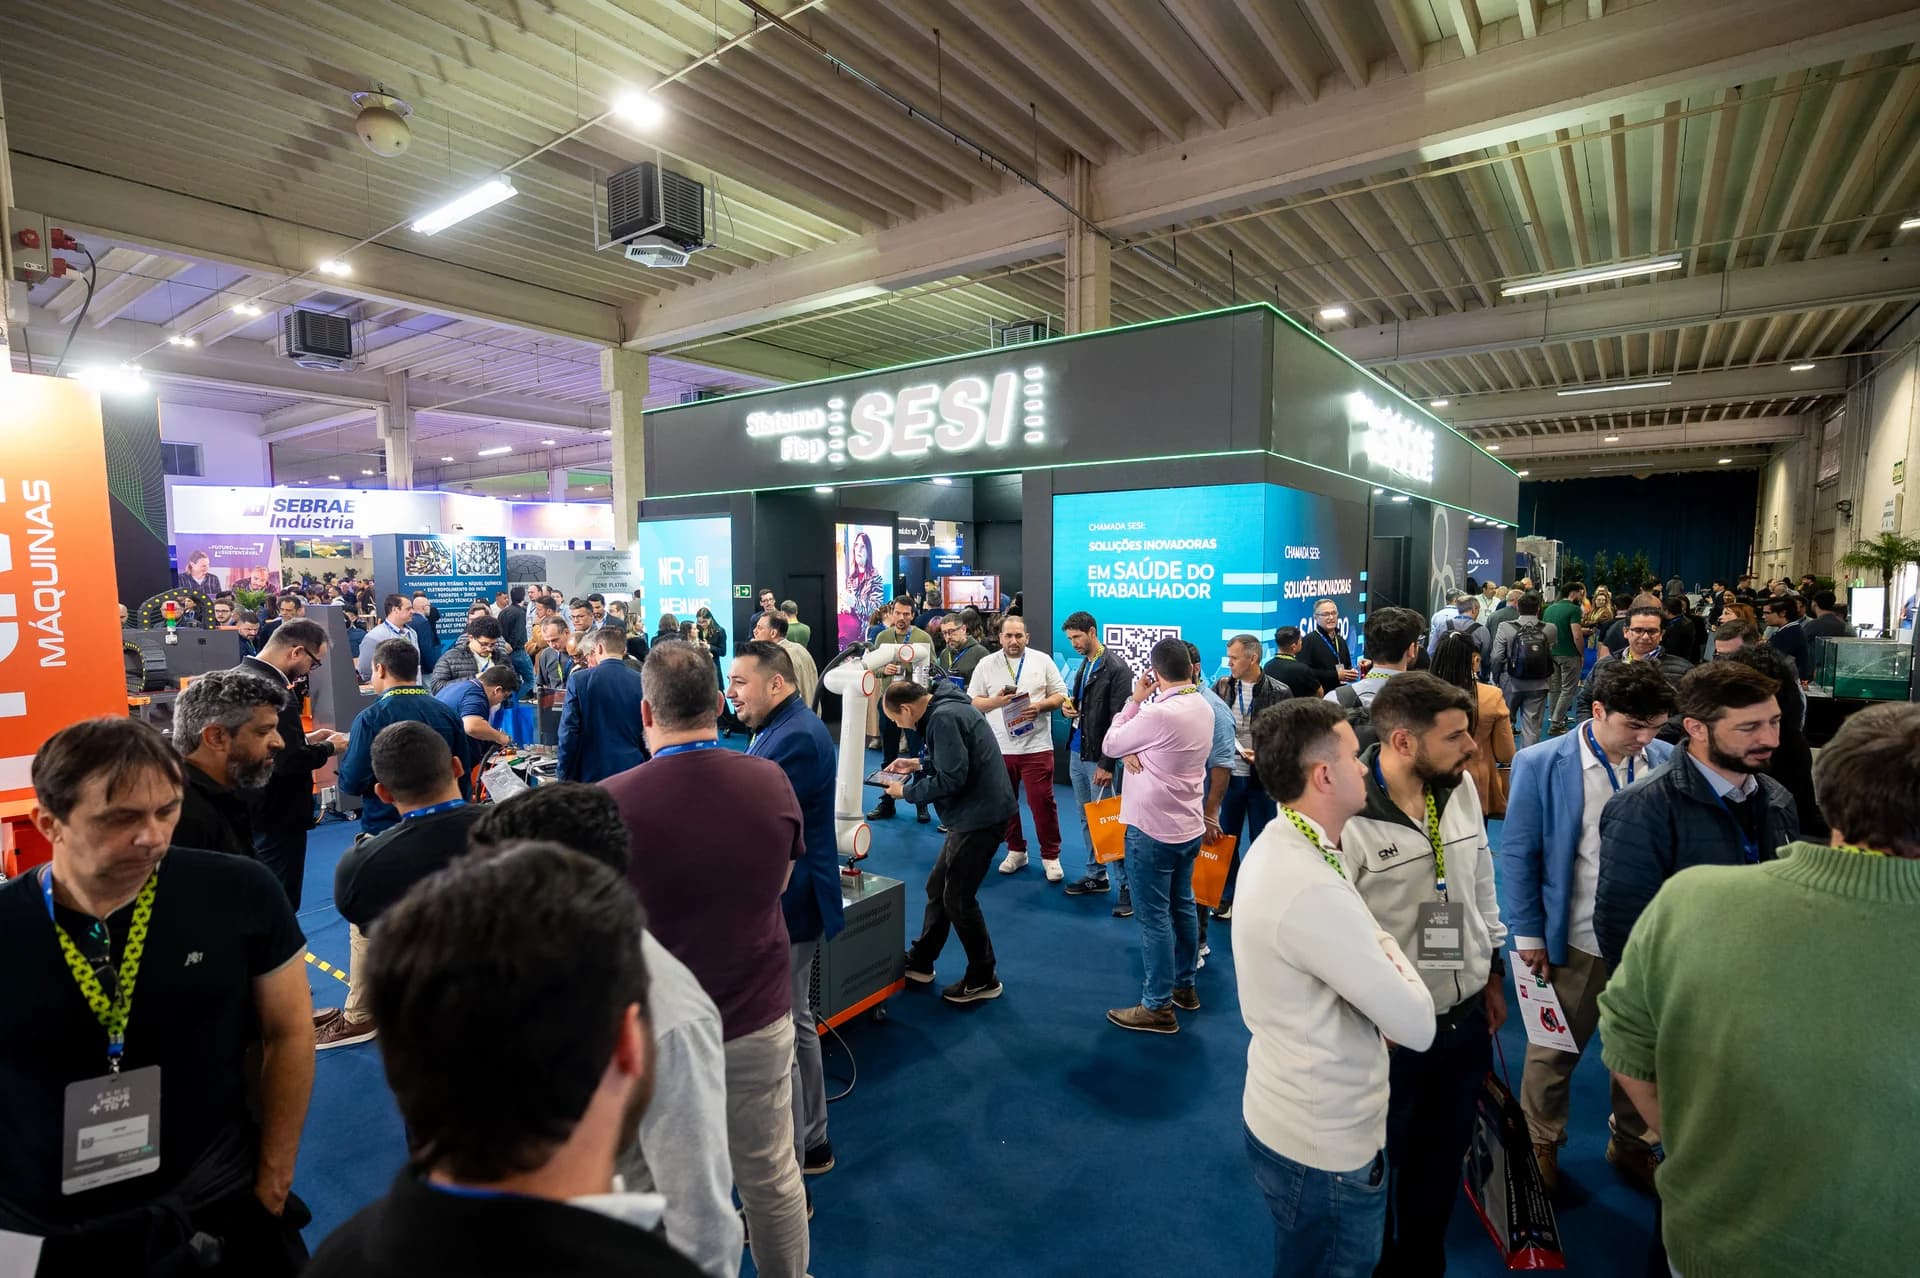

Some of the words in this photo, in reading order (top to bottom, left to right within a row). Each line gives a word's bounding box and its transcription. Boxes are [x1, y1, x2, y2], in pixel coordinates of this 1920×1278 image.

[747, 409, 824, 436] Sistema
[848, 373, 1016, 459] SESI
[782, 437, 825, 462] Fiep
[273, 498, 355, 513] SEBRAE
[270, 514, 354, 529] Indústria
[1088, 523, 1126, 531] CHAMADA
[1088, 538, 1142, 555] SOLUÇÕES
[1144, 538, 1217, 550] INOVADORAS
[1285, 545, 1309, 559] CHAMADA
[21, 479, 67, 668] MÁQUINAS
[1088, 564, 1110, 580] EM
[1113, 556, 1182, 580] SAÚDE
[1187, 563, 1215, 580] DO
[1087, 583, 1212, 599] TRABALHADOR
[1284, 576, 1317, 602] SOLUÇÕES
[1317, 578, 1352, 596] INOVADORAS
[1378, 842, 1398, 858] CNH
